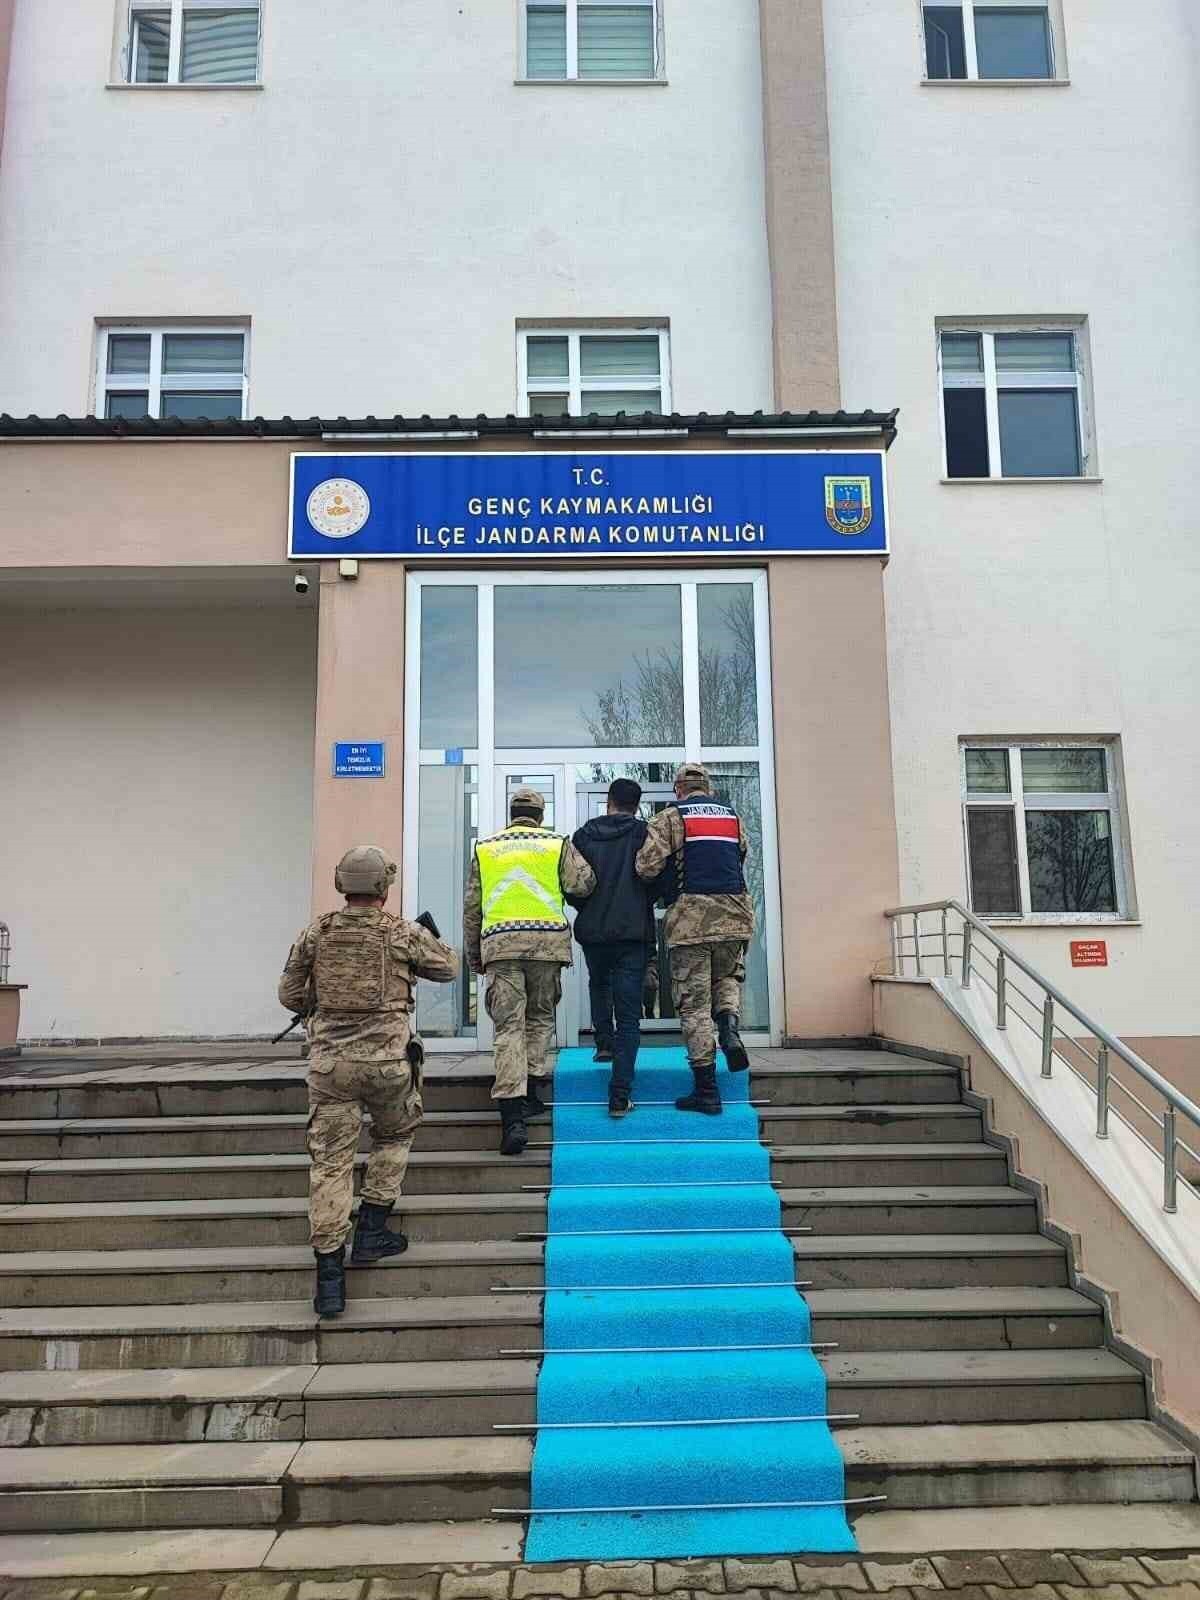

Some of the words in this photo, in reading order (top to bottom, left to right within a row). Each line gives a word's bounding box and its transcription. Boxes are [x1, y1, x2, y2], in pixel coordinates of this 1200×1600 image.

[572, 468, 610, 486] T.C.
[468, 496, 531, 518] GENÇ
[540, 494, 713, 515] KAYMAKAMLIĞI
[416, 524, 465, 548] İLÇE
[475, 526, 601, 544] JANDARMA
[608, 522, 766, 544] KOMUTANLIĞI
[686, 805, 732, 816] JANDARMA
